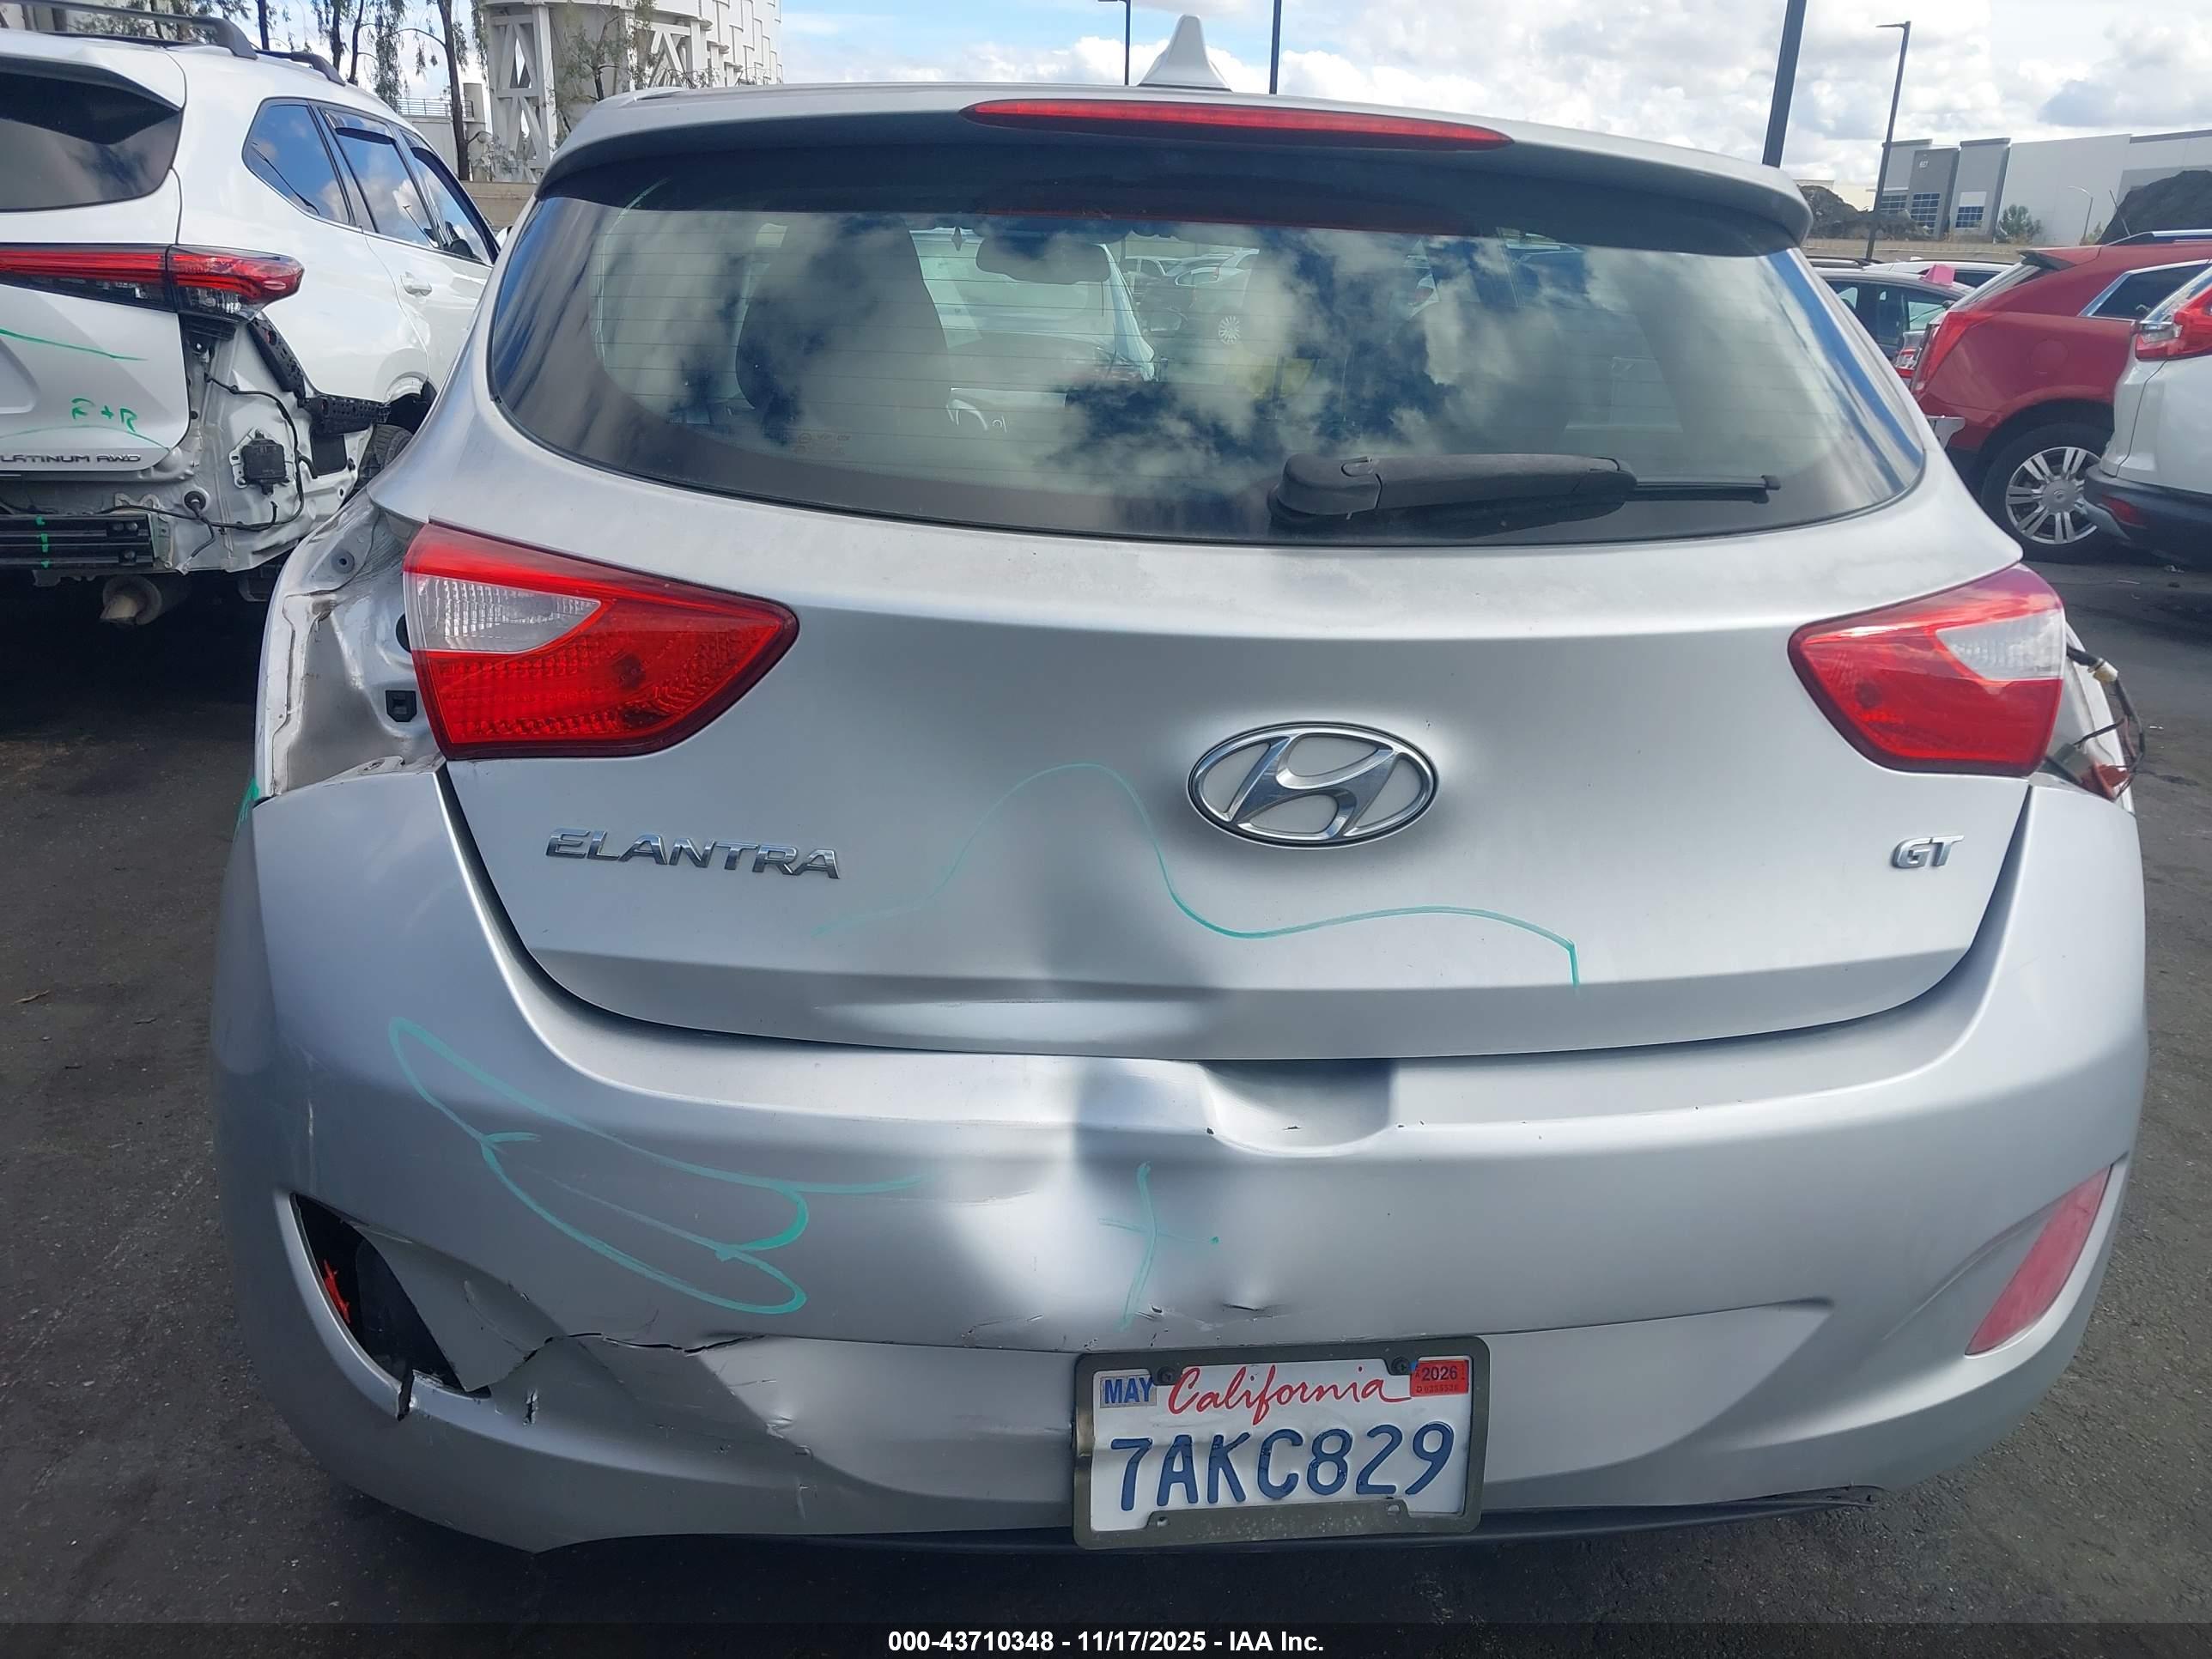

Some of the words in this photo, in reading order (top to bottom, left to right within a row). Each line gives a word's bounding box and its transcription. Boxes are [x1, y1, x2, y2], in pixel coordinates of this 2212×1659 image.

[0, 453, 90, 463] LATINUM
[96, 453, 142, 462] AWD
[545, 827, 840, 880] ELANTRA
[1891, 835, 1965, 869] GT
[1104, 1376, 1154, 1404] MAY
[1421, 1365, 1458, 1382] 2026
[1168, 1364, 1412, 1425] California
[1110, 1421, 1455, 1511] 7AKC829
